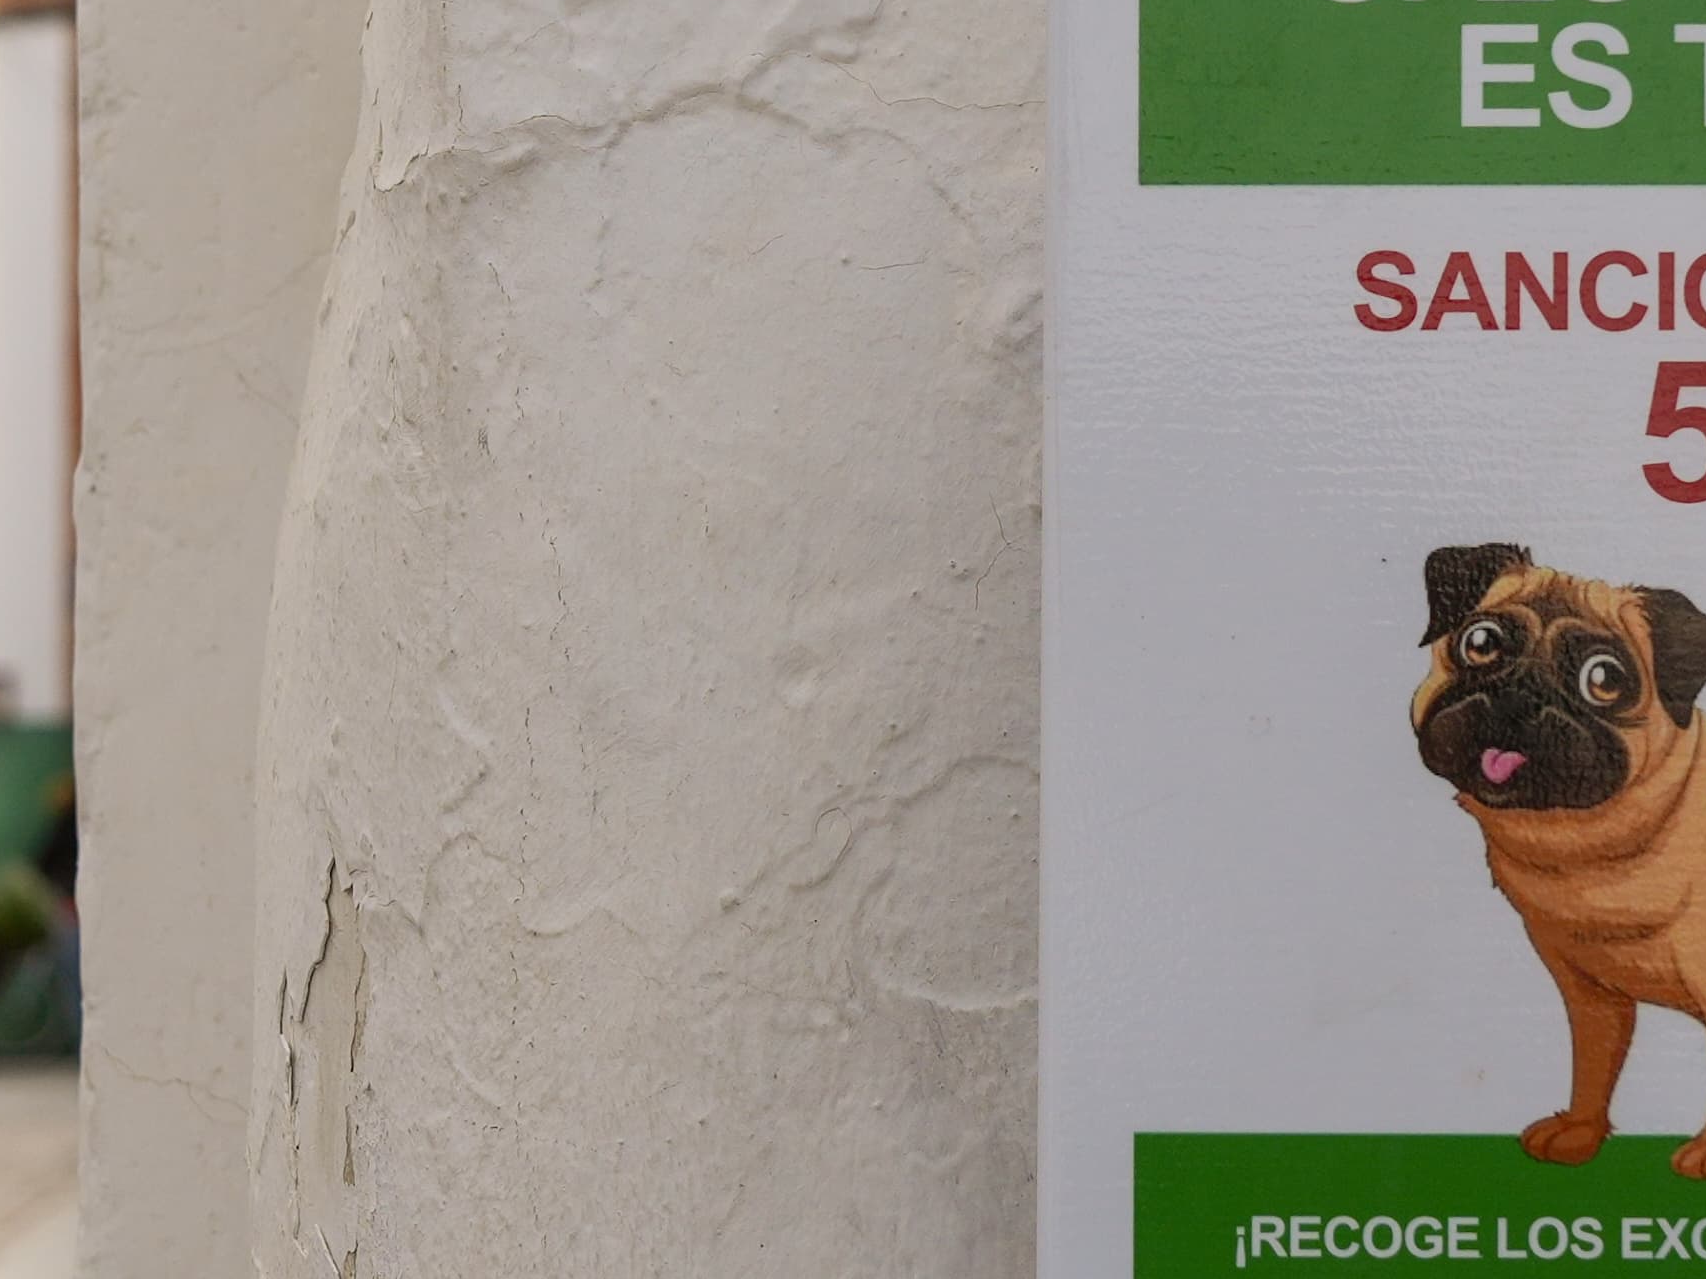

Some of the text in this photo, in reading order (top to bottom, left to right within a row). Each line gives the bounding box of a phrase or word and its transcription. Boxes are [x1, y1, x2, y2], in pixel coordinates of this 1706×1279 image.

[1460, 21, 1634, 130] ES
[1235, 1215, 1481, 1269] ¡RECOGE
[1497, 1216, 1605, 1261] LOS
